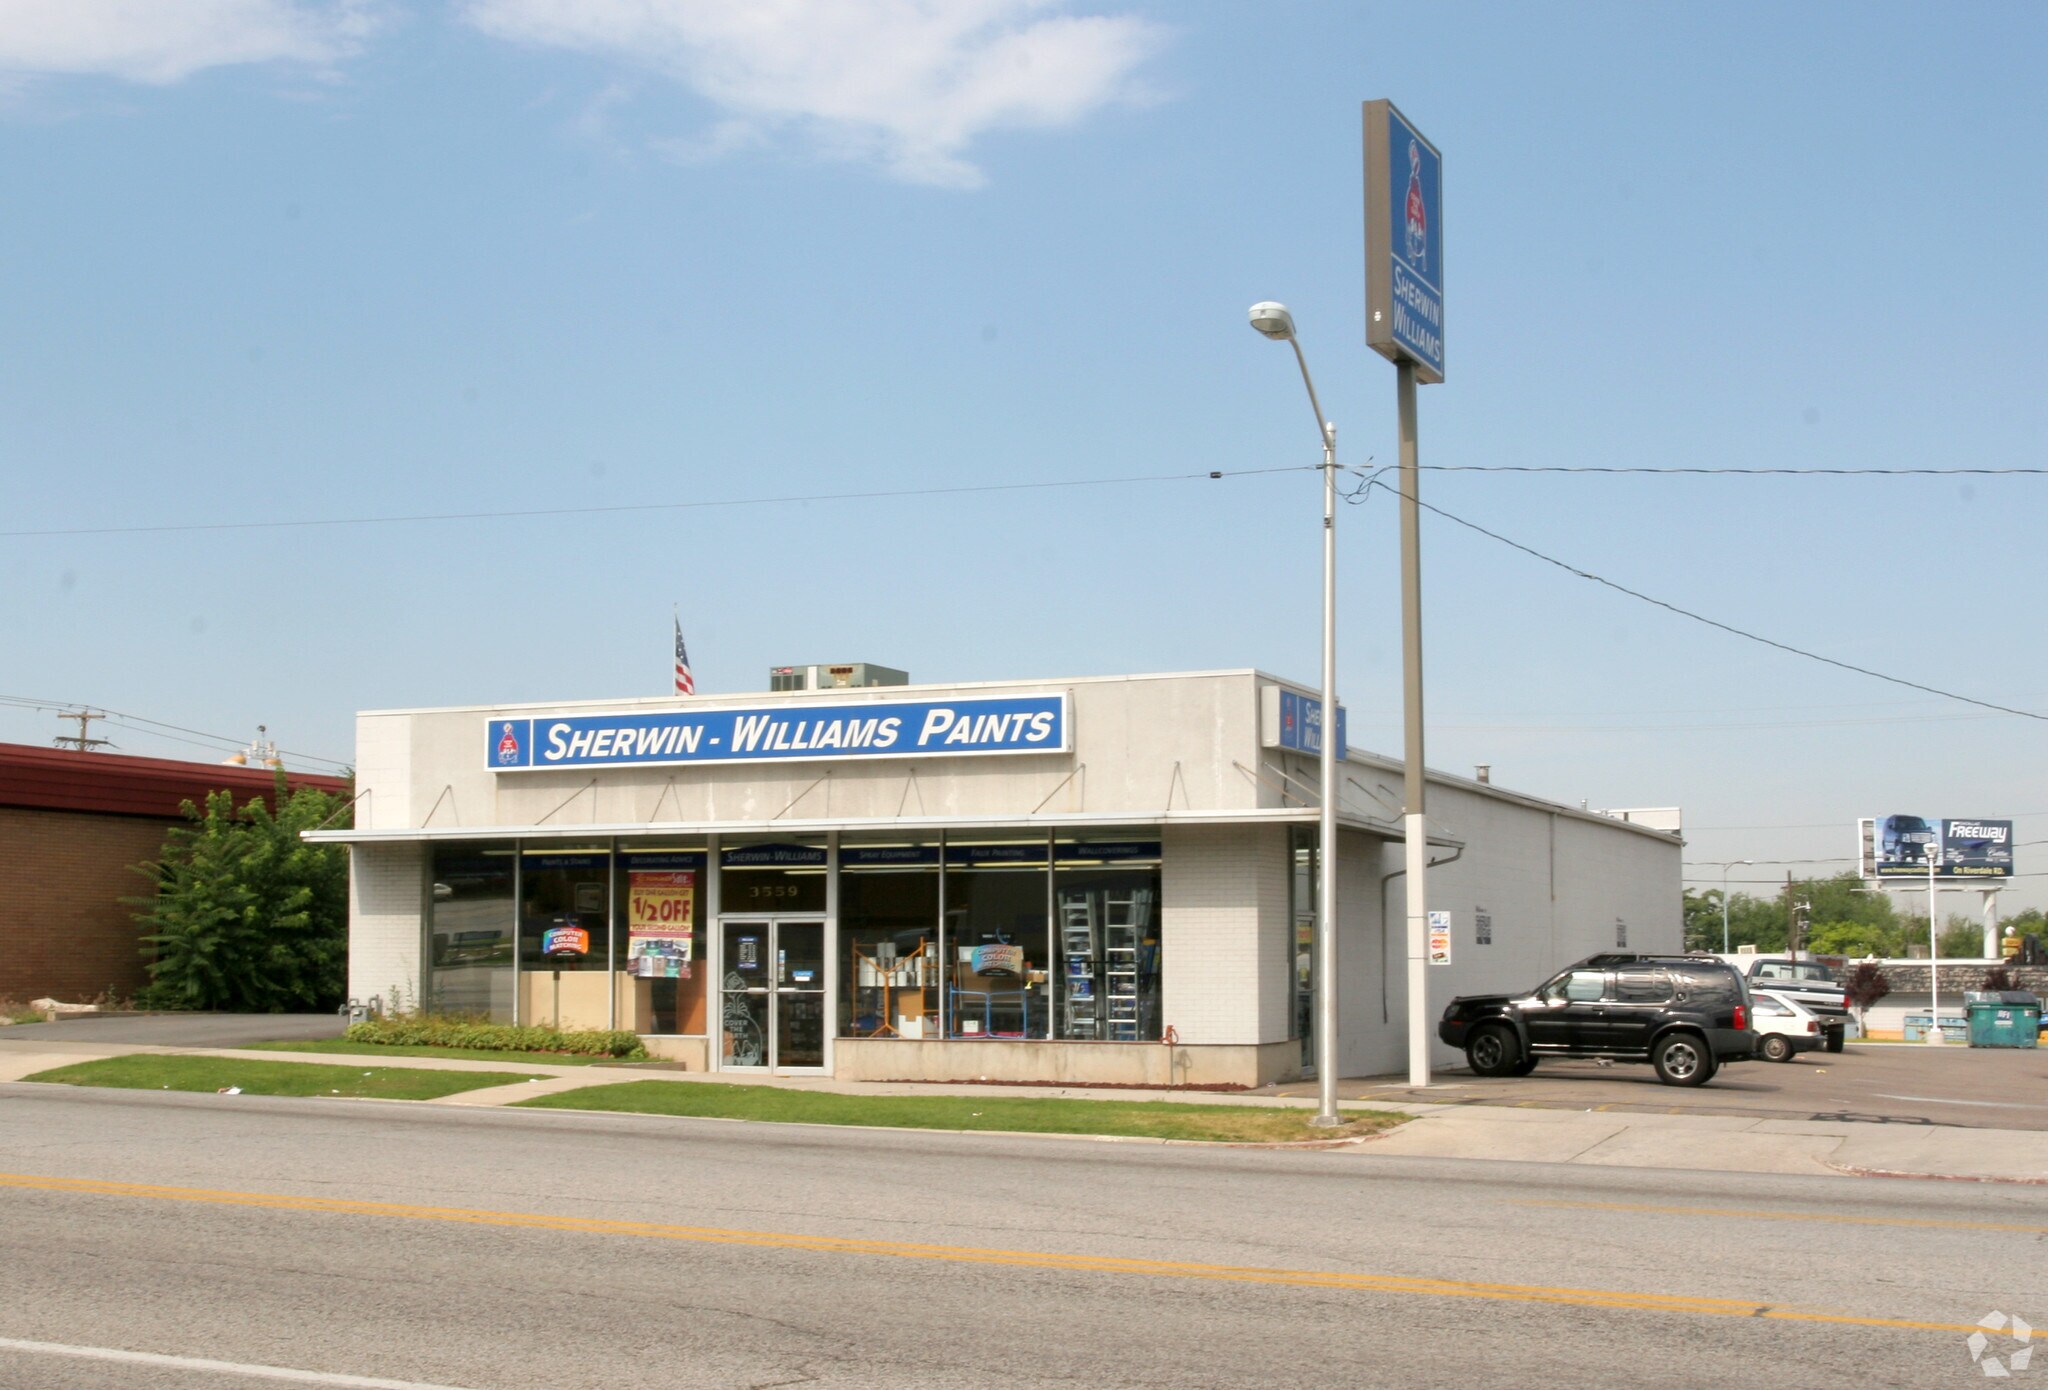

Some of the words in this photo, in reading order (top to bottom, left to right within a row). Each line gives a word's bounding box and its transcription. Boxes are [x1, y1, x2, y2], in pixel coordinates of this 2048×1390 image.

[1394, 265, 1440, 328] SHERWIN
[1394, 299, 1440, 362] WILLIAMS
[730, 714, 902, 753] WILLIAMS
[917, 708, 1055, 746] PAINTS
[632, 896, 658, 921] 1/2
[660, 899, 690, 922] OFF
[750, 885, 799, 898] 3559
